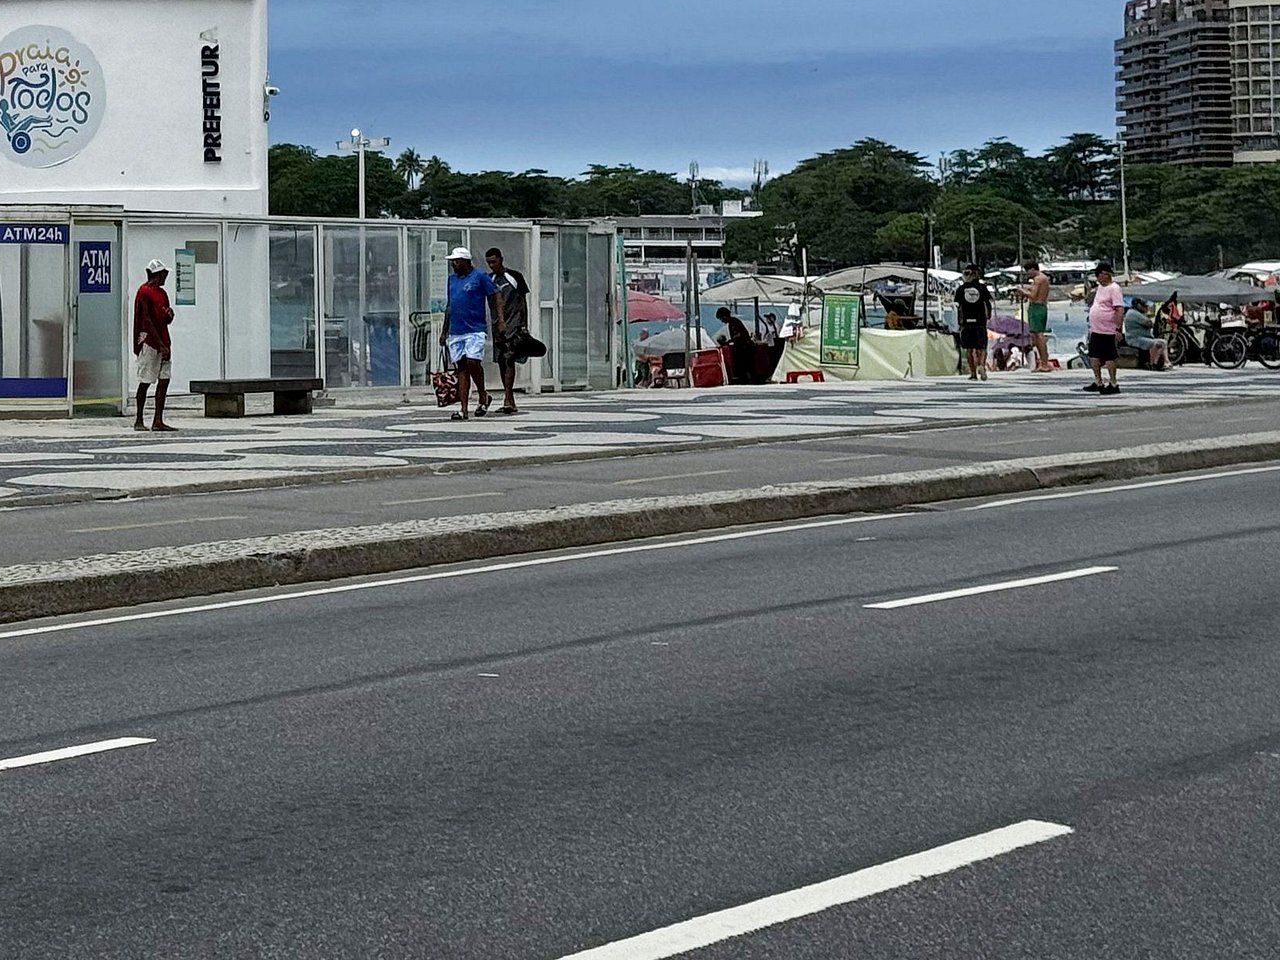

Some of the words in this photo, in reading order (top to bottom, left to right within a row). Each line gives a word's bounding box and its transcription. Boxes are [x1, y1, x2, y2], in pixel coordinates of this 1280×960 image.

[22, 62, 49, 76] para
[7, 67, 91, 124] Todos
[2, 227, 63, 241] ATM24h
[81, 250, 110, 267] ATM
[87, 268, 110, 285] 24h
